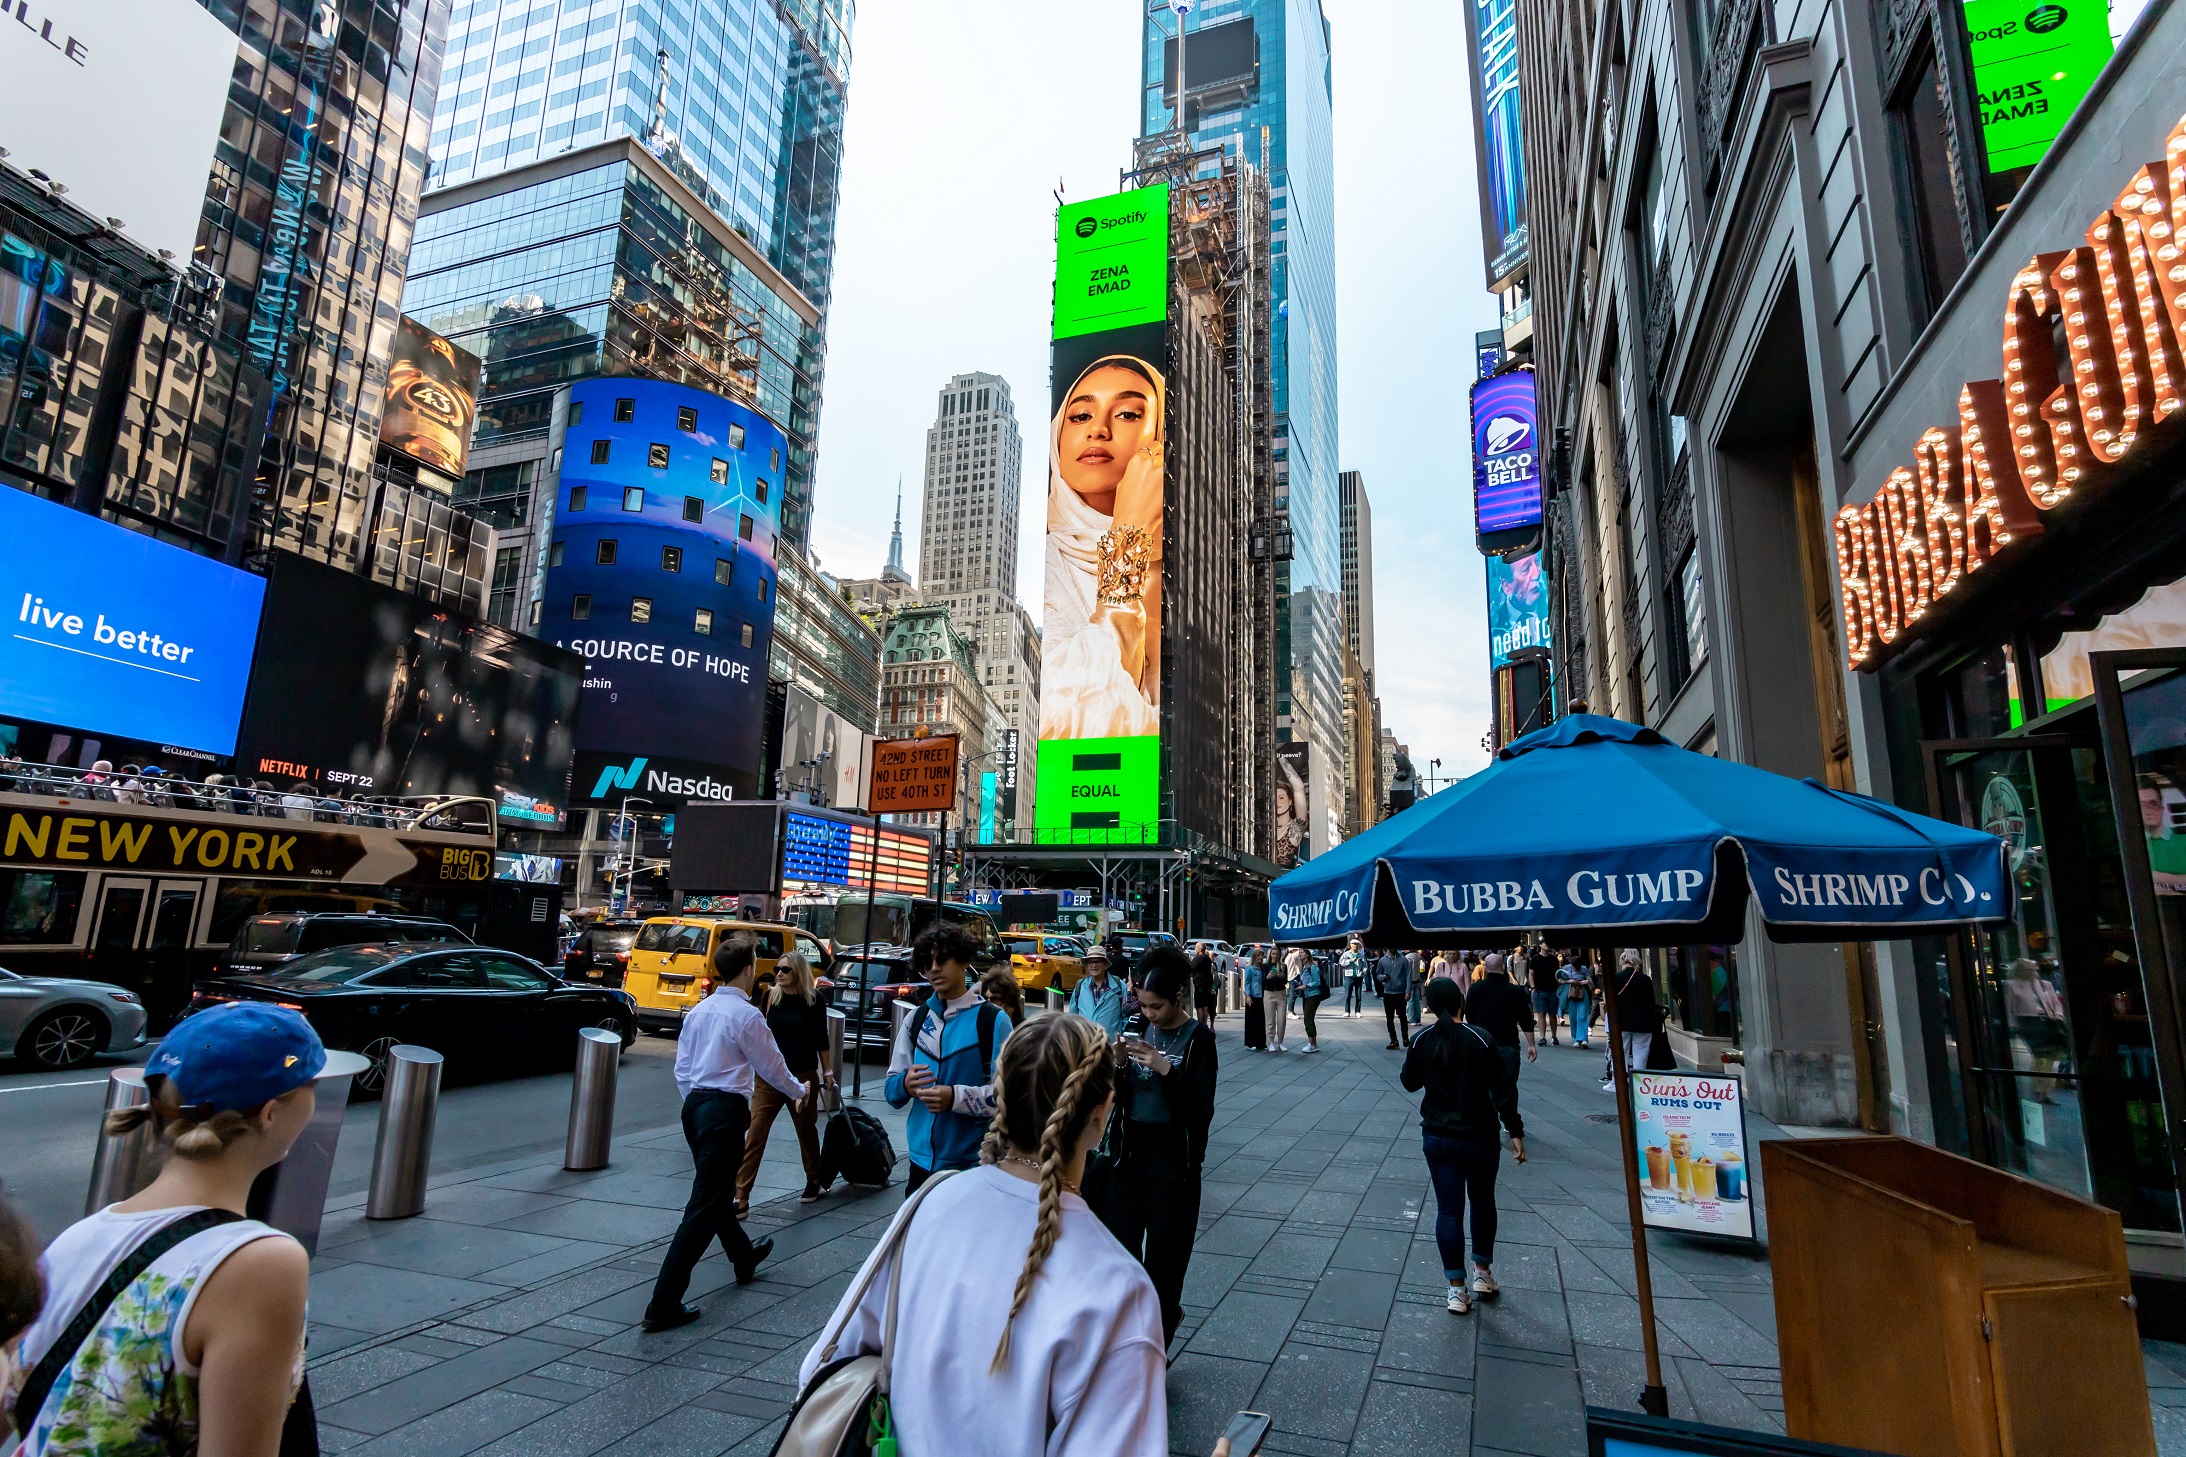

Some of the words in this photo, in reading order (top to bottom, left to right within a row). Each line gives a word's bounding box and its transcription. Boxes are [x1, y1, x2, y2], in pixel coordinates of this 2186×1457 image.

[1100, 210, 1148, 231] Spotify
[1089, 264, 1130, 282] ZENA
[1087, 279, 1131, 297] EMAD
[413, 387, 451, 413] 43
[1484, 452, 1532, 474] TACO
[1487, 467, 1533, 487] BELL
[1832, 382, 2012, 671] BUBBA
[531, 499, 555, 602] NASDAQ
[19, 592, 84, 636] live
[93, 613, 194, 665] better
[571, 639, 663, 664] SOURCE
[672, 648, 699, 669] OF
[706, 655, 750, 684] HOPE
[880, 752, 906, 765] 42ND
[911, 748, 950, 764] STREET
[259, 758, 308, 779] NETFLIX
[327, 770, 357, 786] SEPT
[359, 775, 373, 787] 22
[875, 769, 889, 783] NO
[893, 767, 919, 782] LEFT
[924, 766, 950, 780] TURN
[1006, 766, 1016, 788] Foot
[647, 770, 733, 801] Nasdaq
[877, 786, 896, 800] USE
[901, 785, 929, 799] 40TH
[933, 784, 947, 797] ST
[1071, 784, 1120, 798] EQUAL
[4, 812, 154, 862] NEW
[169, 826, 299, 872] YORK
[442, 848, 471, 865] BIG
[439, 864, 468, 880] BUS
[1412, 879, 1554, 914] BUBBA
[1567, 869, 1704, 909] GUMP
[1774, 866, 1909, 906] SHRIMP
[1063, 891, 1092, 907] DEPT
[1274, 899, 1333, 930] SHRIMP
[1639, 1077, 1692, 1098] Sun's
[1696, 1081, 1736, 1101] Out
[1650, 1097, 1689, 1108] RUMS
[1693, 1100, 1722, 1111] OUT
